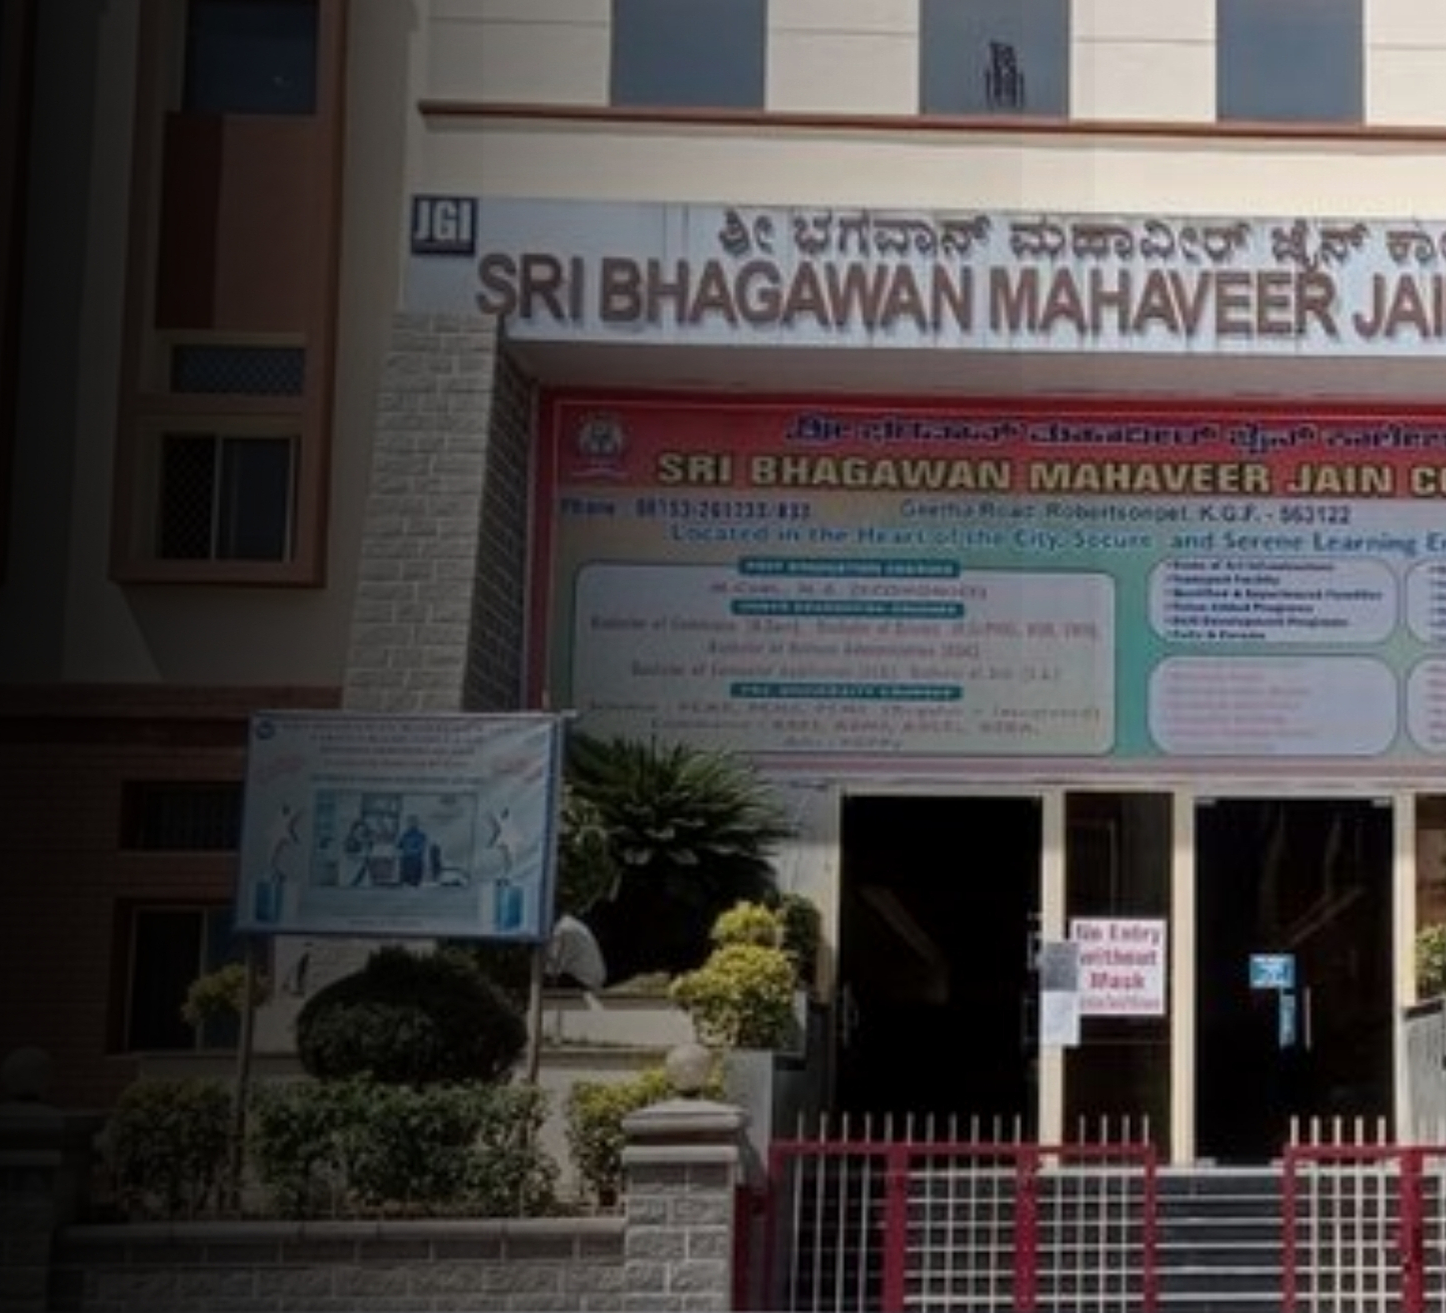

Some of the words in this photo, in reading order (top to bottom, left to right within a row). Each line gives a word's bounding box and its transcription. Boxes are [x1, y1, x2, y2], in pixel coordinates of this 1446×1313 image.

[414, 201, 474, 241] JGI
[793, 208, 993, 258] ಭಗವಾನ್
[476, 252, 585, 320] SRI
[600, 259, 972, 332] BHAGAWAN
[990, 267, 1335, 338] MAHAVEER
[658, 453, 731, 483] SRI
[750, 455, 1012, 488] BHAGAWAN
[1029, 460, 1270, 493] MAHAVEER
[1286, 464, 1393, 495] JAIN
[670, 524, 769, 543] Located
[778, 525, 800, 542] in
[810, 527, 848, 543] the
[858, 527, 925, 544] Heart
[936, 527, 958, 545] of
[966, 528, 1004, 546] the
[1169, 529, 1214, 549] and
[1222, 530, 1303, 551] Serene
[1312, 531, 1417, 556] Learning
[1076, 923, 1103, 942] No
[1110, 923, 1161, 946] Entry
[1079, 947, 1157, 967] without
[1089, 972, 1145, 991] Mask
